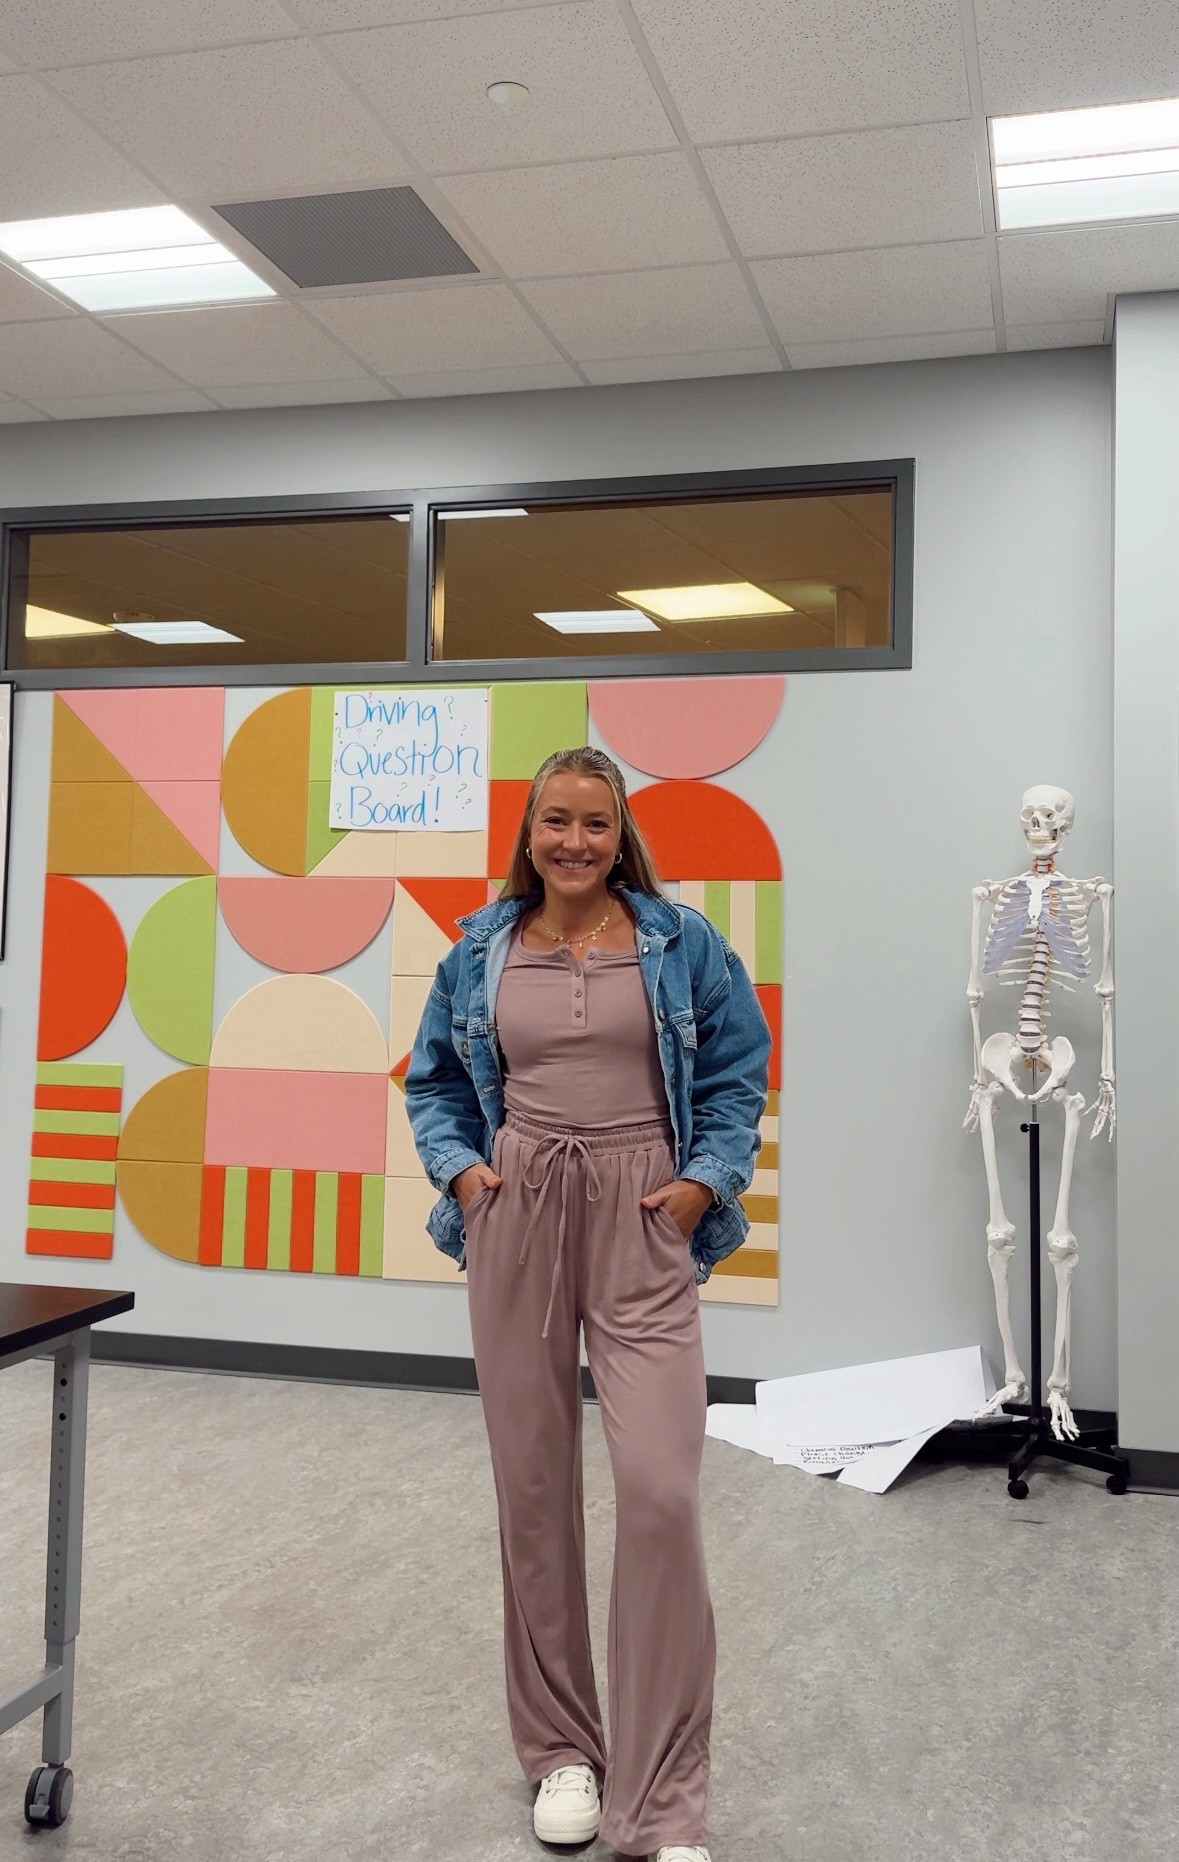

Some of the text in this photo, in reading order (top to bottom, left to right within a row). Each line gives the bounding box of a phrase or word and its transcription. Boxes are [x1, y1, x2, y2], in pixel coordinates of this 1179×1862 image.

[345, 694, 438, 757] Driving
[340, 740, 482, 779] Question
[350, 786, 440, 827] Board!
